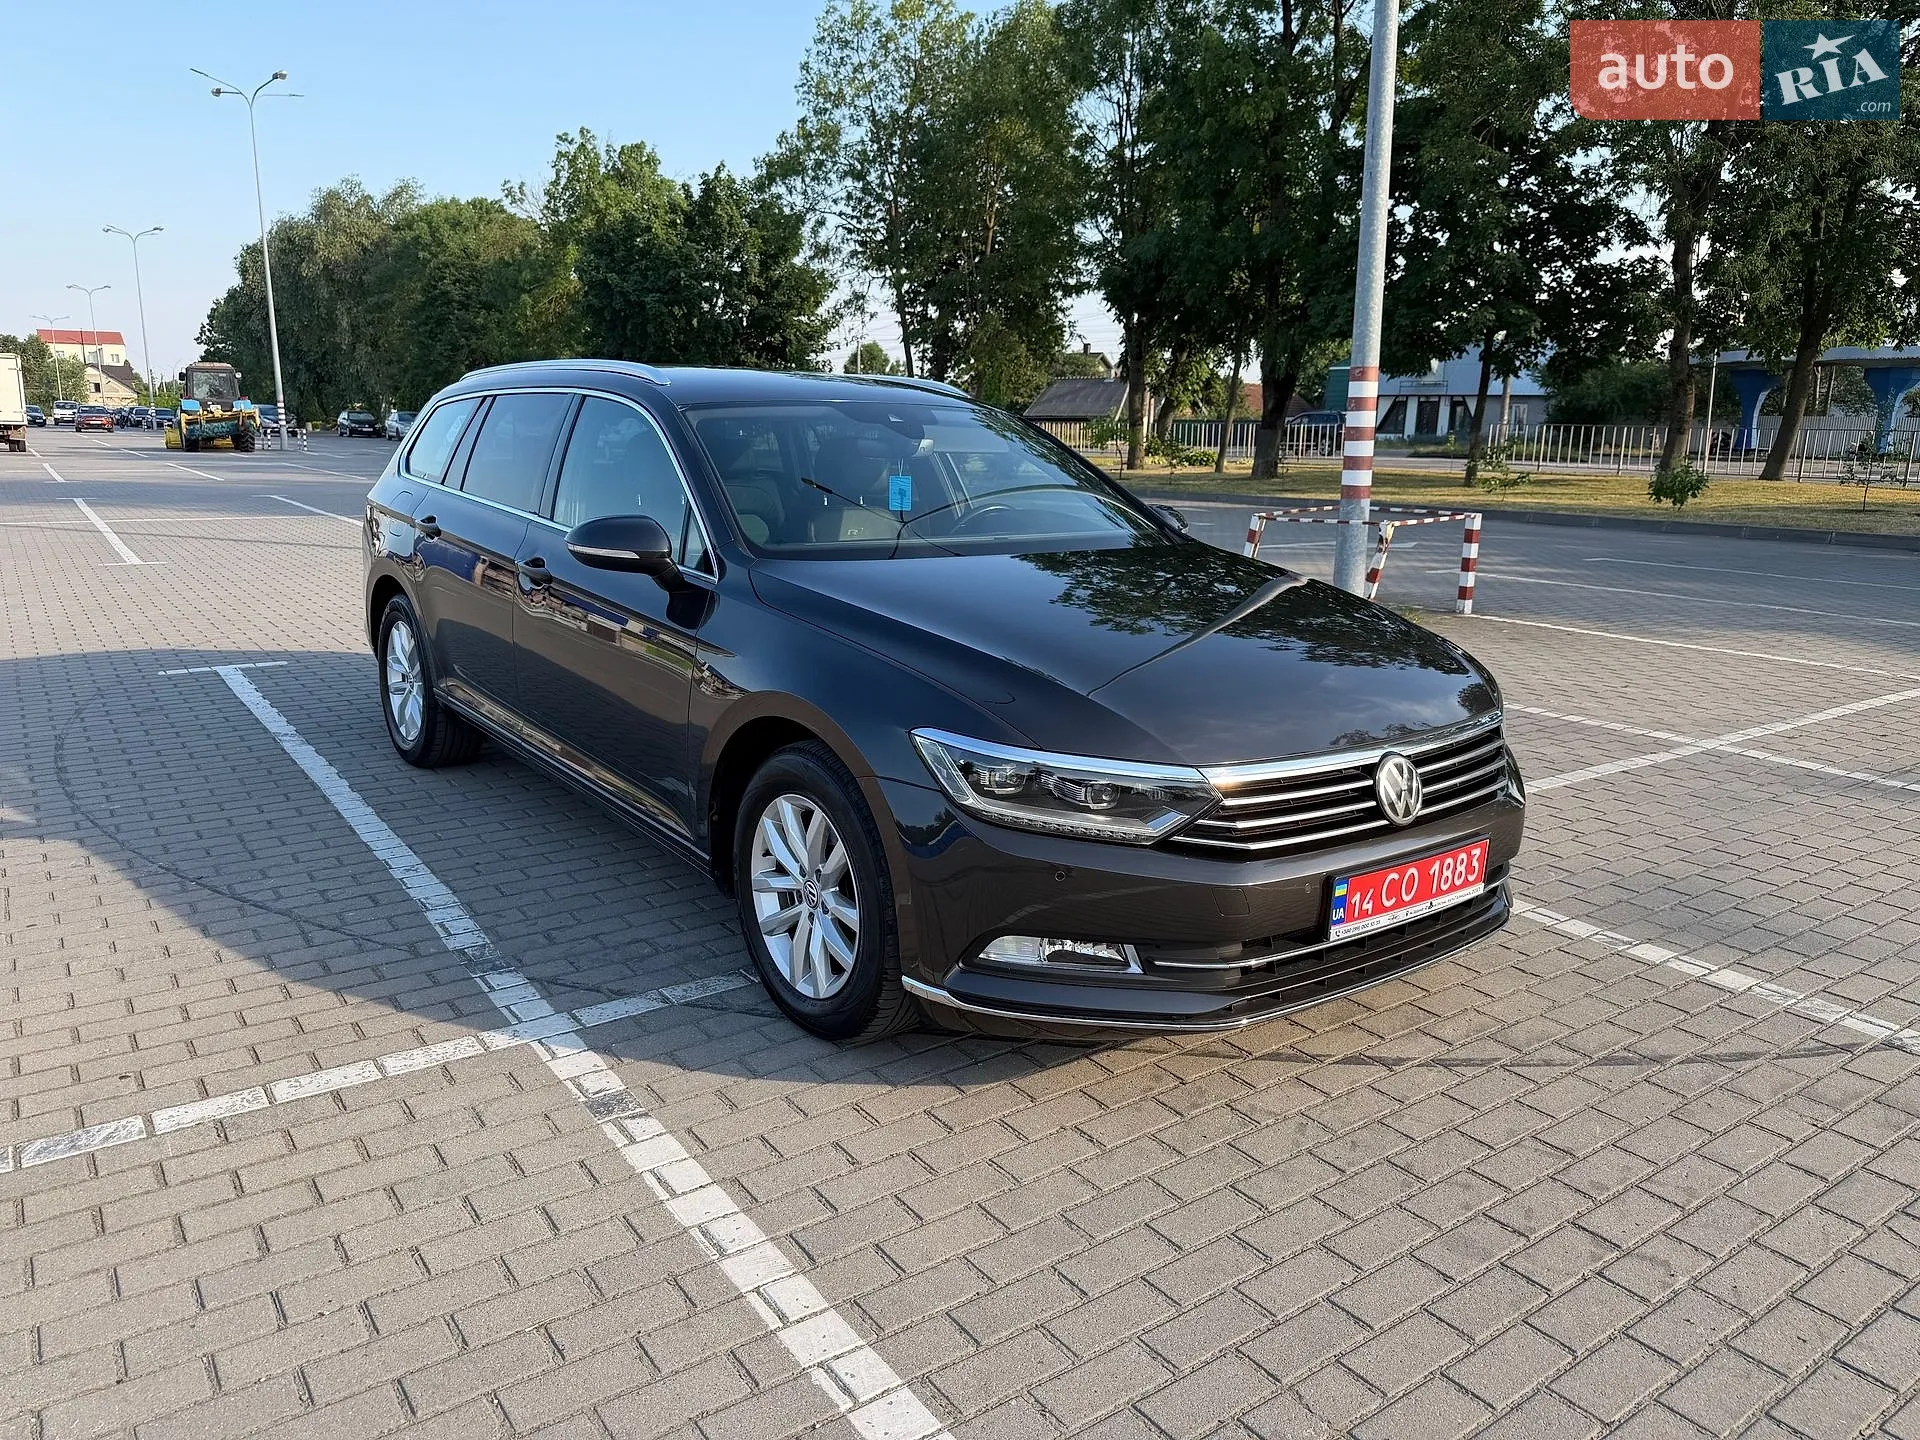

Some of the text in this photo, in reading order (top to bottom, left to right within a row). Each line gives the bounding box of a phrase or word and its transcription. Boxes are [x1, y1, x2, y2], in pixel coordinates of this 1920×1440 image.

[1350, 887, 1375, 917] 14
[1381, 867, 1419, 907] CO
[1429, 847, 1481, 894] 1883
[1332, 907, 1345, 921] UA
